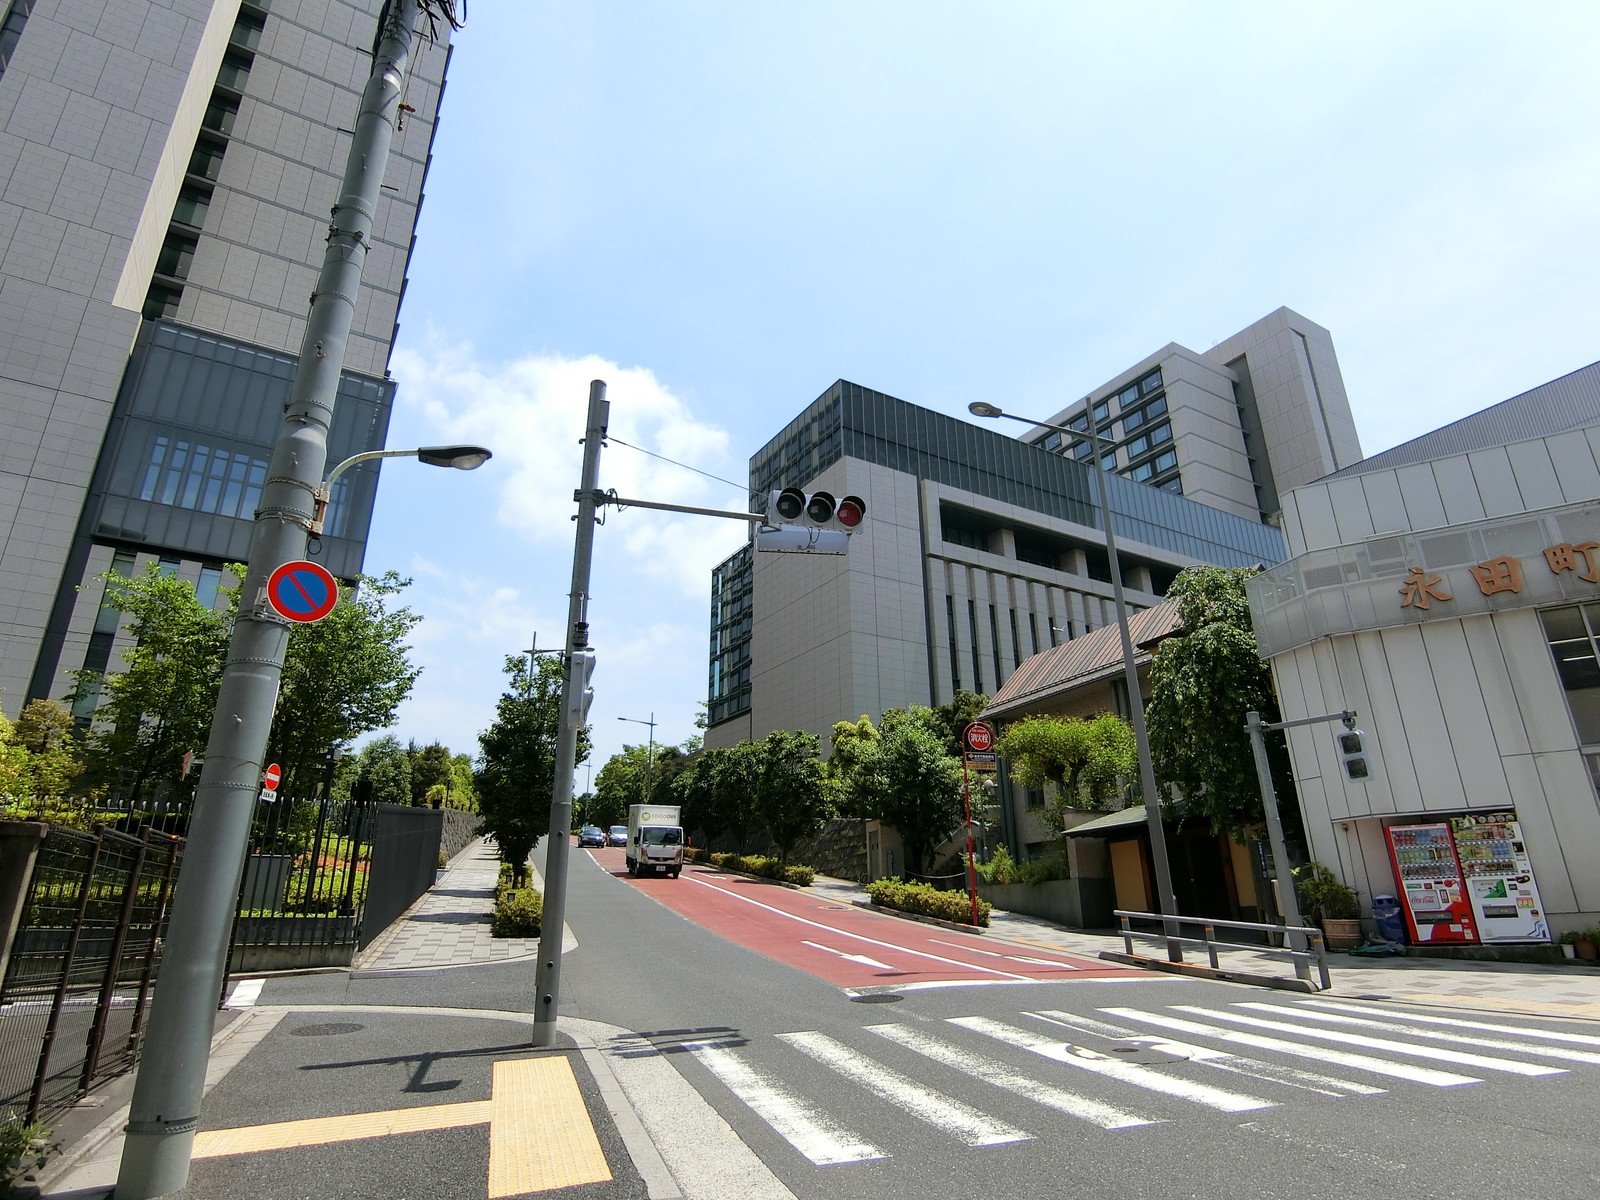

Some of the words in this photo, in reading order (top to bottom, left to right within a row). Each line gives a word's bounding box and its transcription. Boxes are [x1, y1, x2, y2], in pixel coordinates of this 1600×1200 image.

[1398, 540, 1600, 610] 永田町
[971, 733, 989, 743] 消火栓
